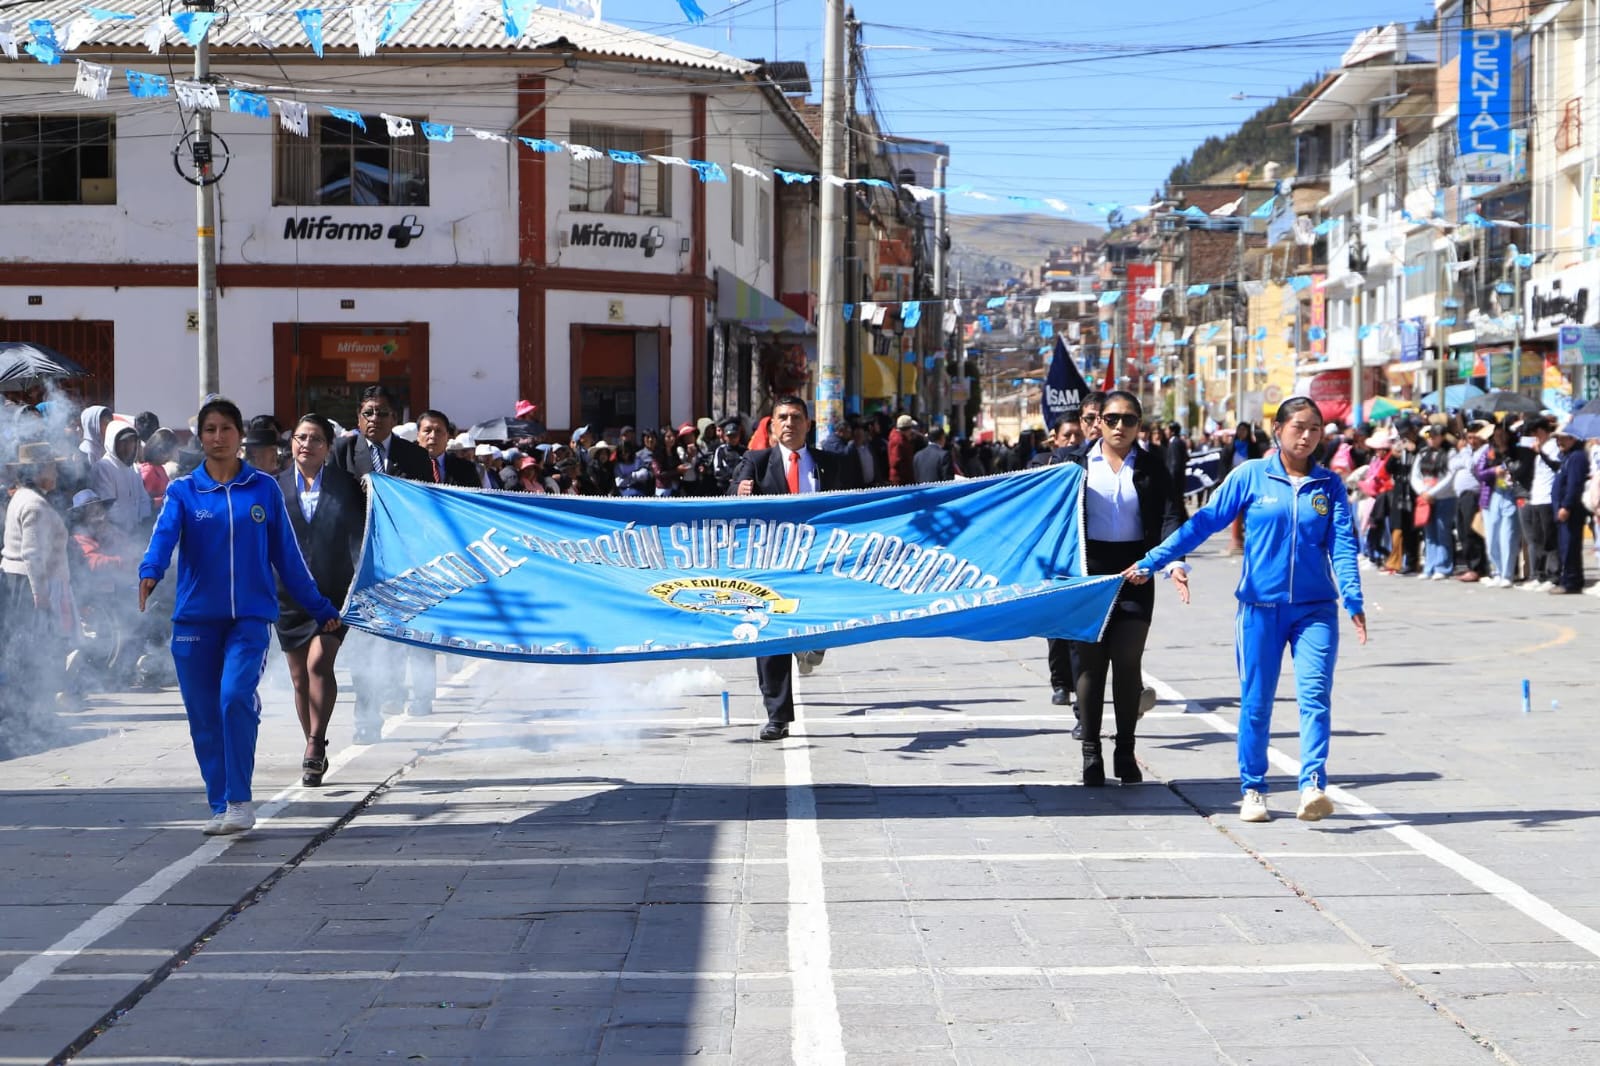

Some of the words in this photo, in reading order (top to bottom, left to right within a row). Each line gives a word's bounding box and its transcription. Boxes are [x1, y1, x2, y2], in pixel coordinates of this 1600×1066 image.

[1470, 31, 1499, 150] DENTAL
[284, 216, 383, 240] Mifarma
[570, 223, 637, 248] Mifarma
[1046, 384, 1081, 405] ISAM
[466, 527, 528, 577] DE
[670, 518, 816, 571] SUPERIOR
